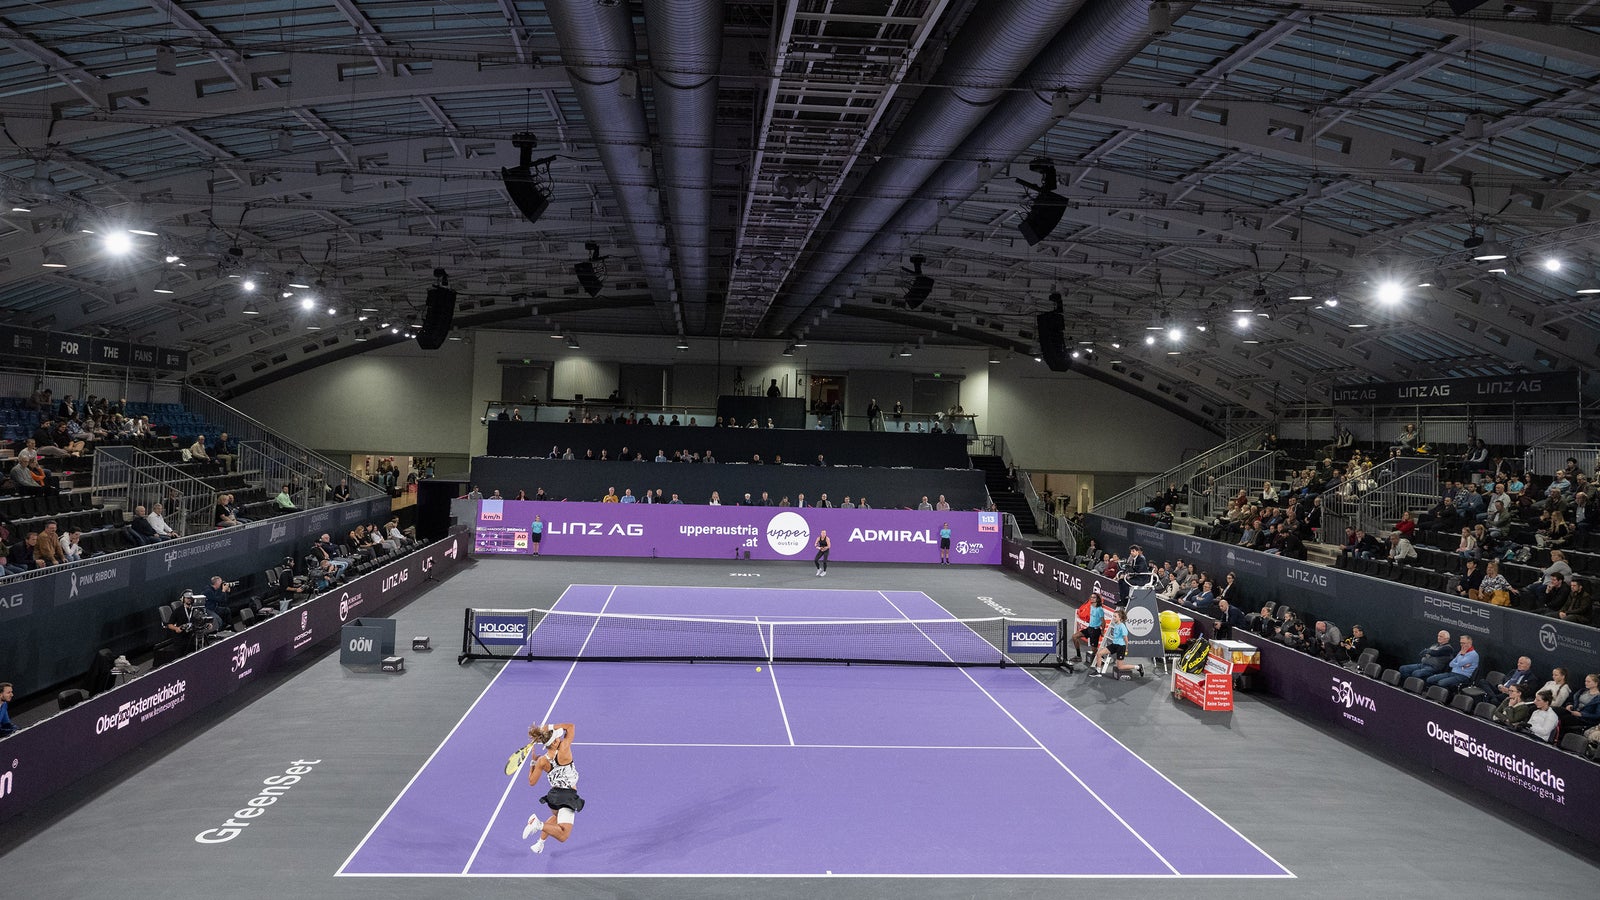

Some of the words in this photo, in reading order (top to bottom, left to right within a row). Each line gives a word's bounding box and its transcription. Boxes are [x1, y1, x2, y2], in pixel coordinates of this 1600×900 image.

[60, 341, 79, 355] FOR
[103, 346, 119, 359] THE
[134, 350, 153, 362] FANS
[1398, 386, 1428, 398] LINZ
[1429, 385, 1451, 396] AG
[1477, 382, 1515, 394] LINZ
[1517, 380, 1542, 393] AG
[1334, 389, 1357, 401] LINZ
[1357, 389, 1377, 400] AG
[547, 522, 603, 535] LINZ
[608, 523, 644, 536] AG
[679, 524, 759, 536] upperaustria
[766, 530, 810, 539] upper
[848, 527, 938, 545] ADMIRAL
[742, 537, 758, 547] .at
[79, 574, 94, 587] PINK
[94, 568, 117, 582] RIBBON
[382, 572, 398, 593] LINZ
[398, 568, 409, 584] AG
[1069, 577, 1082, 591] AG
[1286, 567, 1310, 584] LINZ
[1310, 574, 1328, 587] AG
[1423, 595, 1490, 619] PORSCHE
[479, 623, 526, 632] HOLOGIC
[1011, 632, 1055, 641] HOLOGIC
[1557, 634, 1592, 648] PORSCHE
[349, 636, 373, 652] OÖN
[1353, 694, 1377, 712] WTA
[1486, 763, 1566, 805] www.keinesorgen.at
[194, 758, 322, 844] GreenSet
